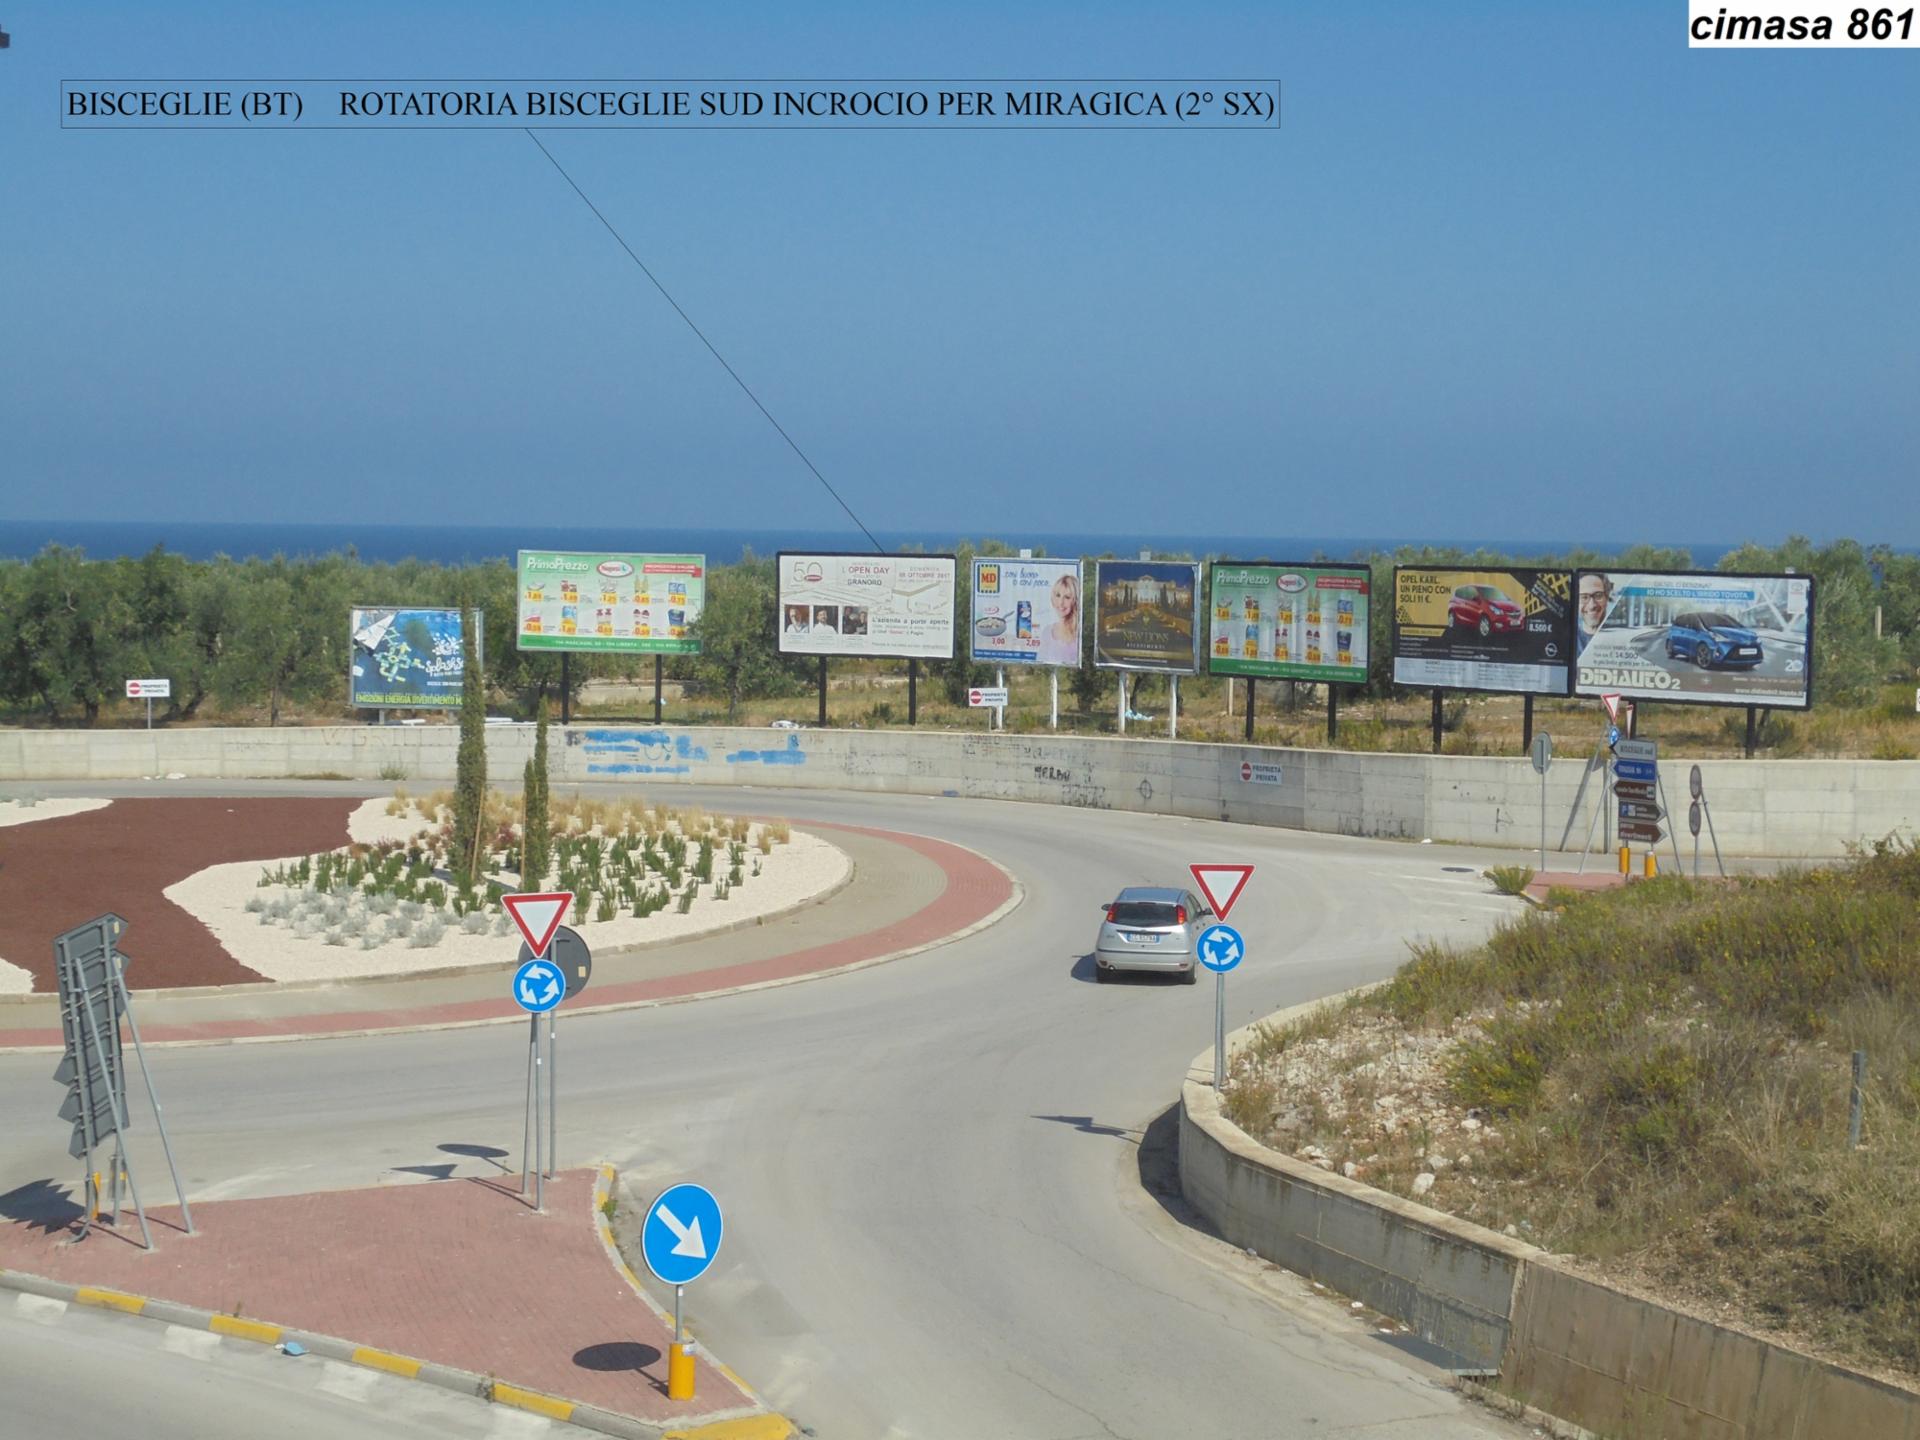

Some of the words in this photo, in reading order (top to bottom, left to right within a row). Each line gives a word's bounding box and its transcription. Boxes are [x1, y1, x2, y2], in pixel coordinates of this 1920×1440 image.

[848, 566, 871, 575] OPEN
[873, 567, 890, 575] DAY
[981, 573, 996, 583] MD
[1400, 575, 1418, 584] OPEL
[1400, 585, 1411, 593] UN
[1412, 585, 1433, 594] PIENO
[1434, 586, 1451, 595] CON
[1666, 590, 1691, 598] SCELTO
[1400, 595, 1416, 603] SOLI
[1256, 774, 1278, 782] PRIVATA
